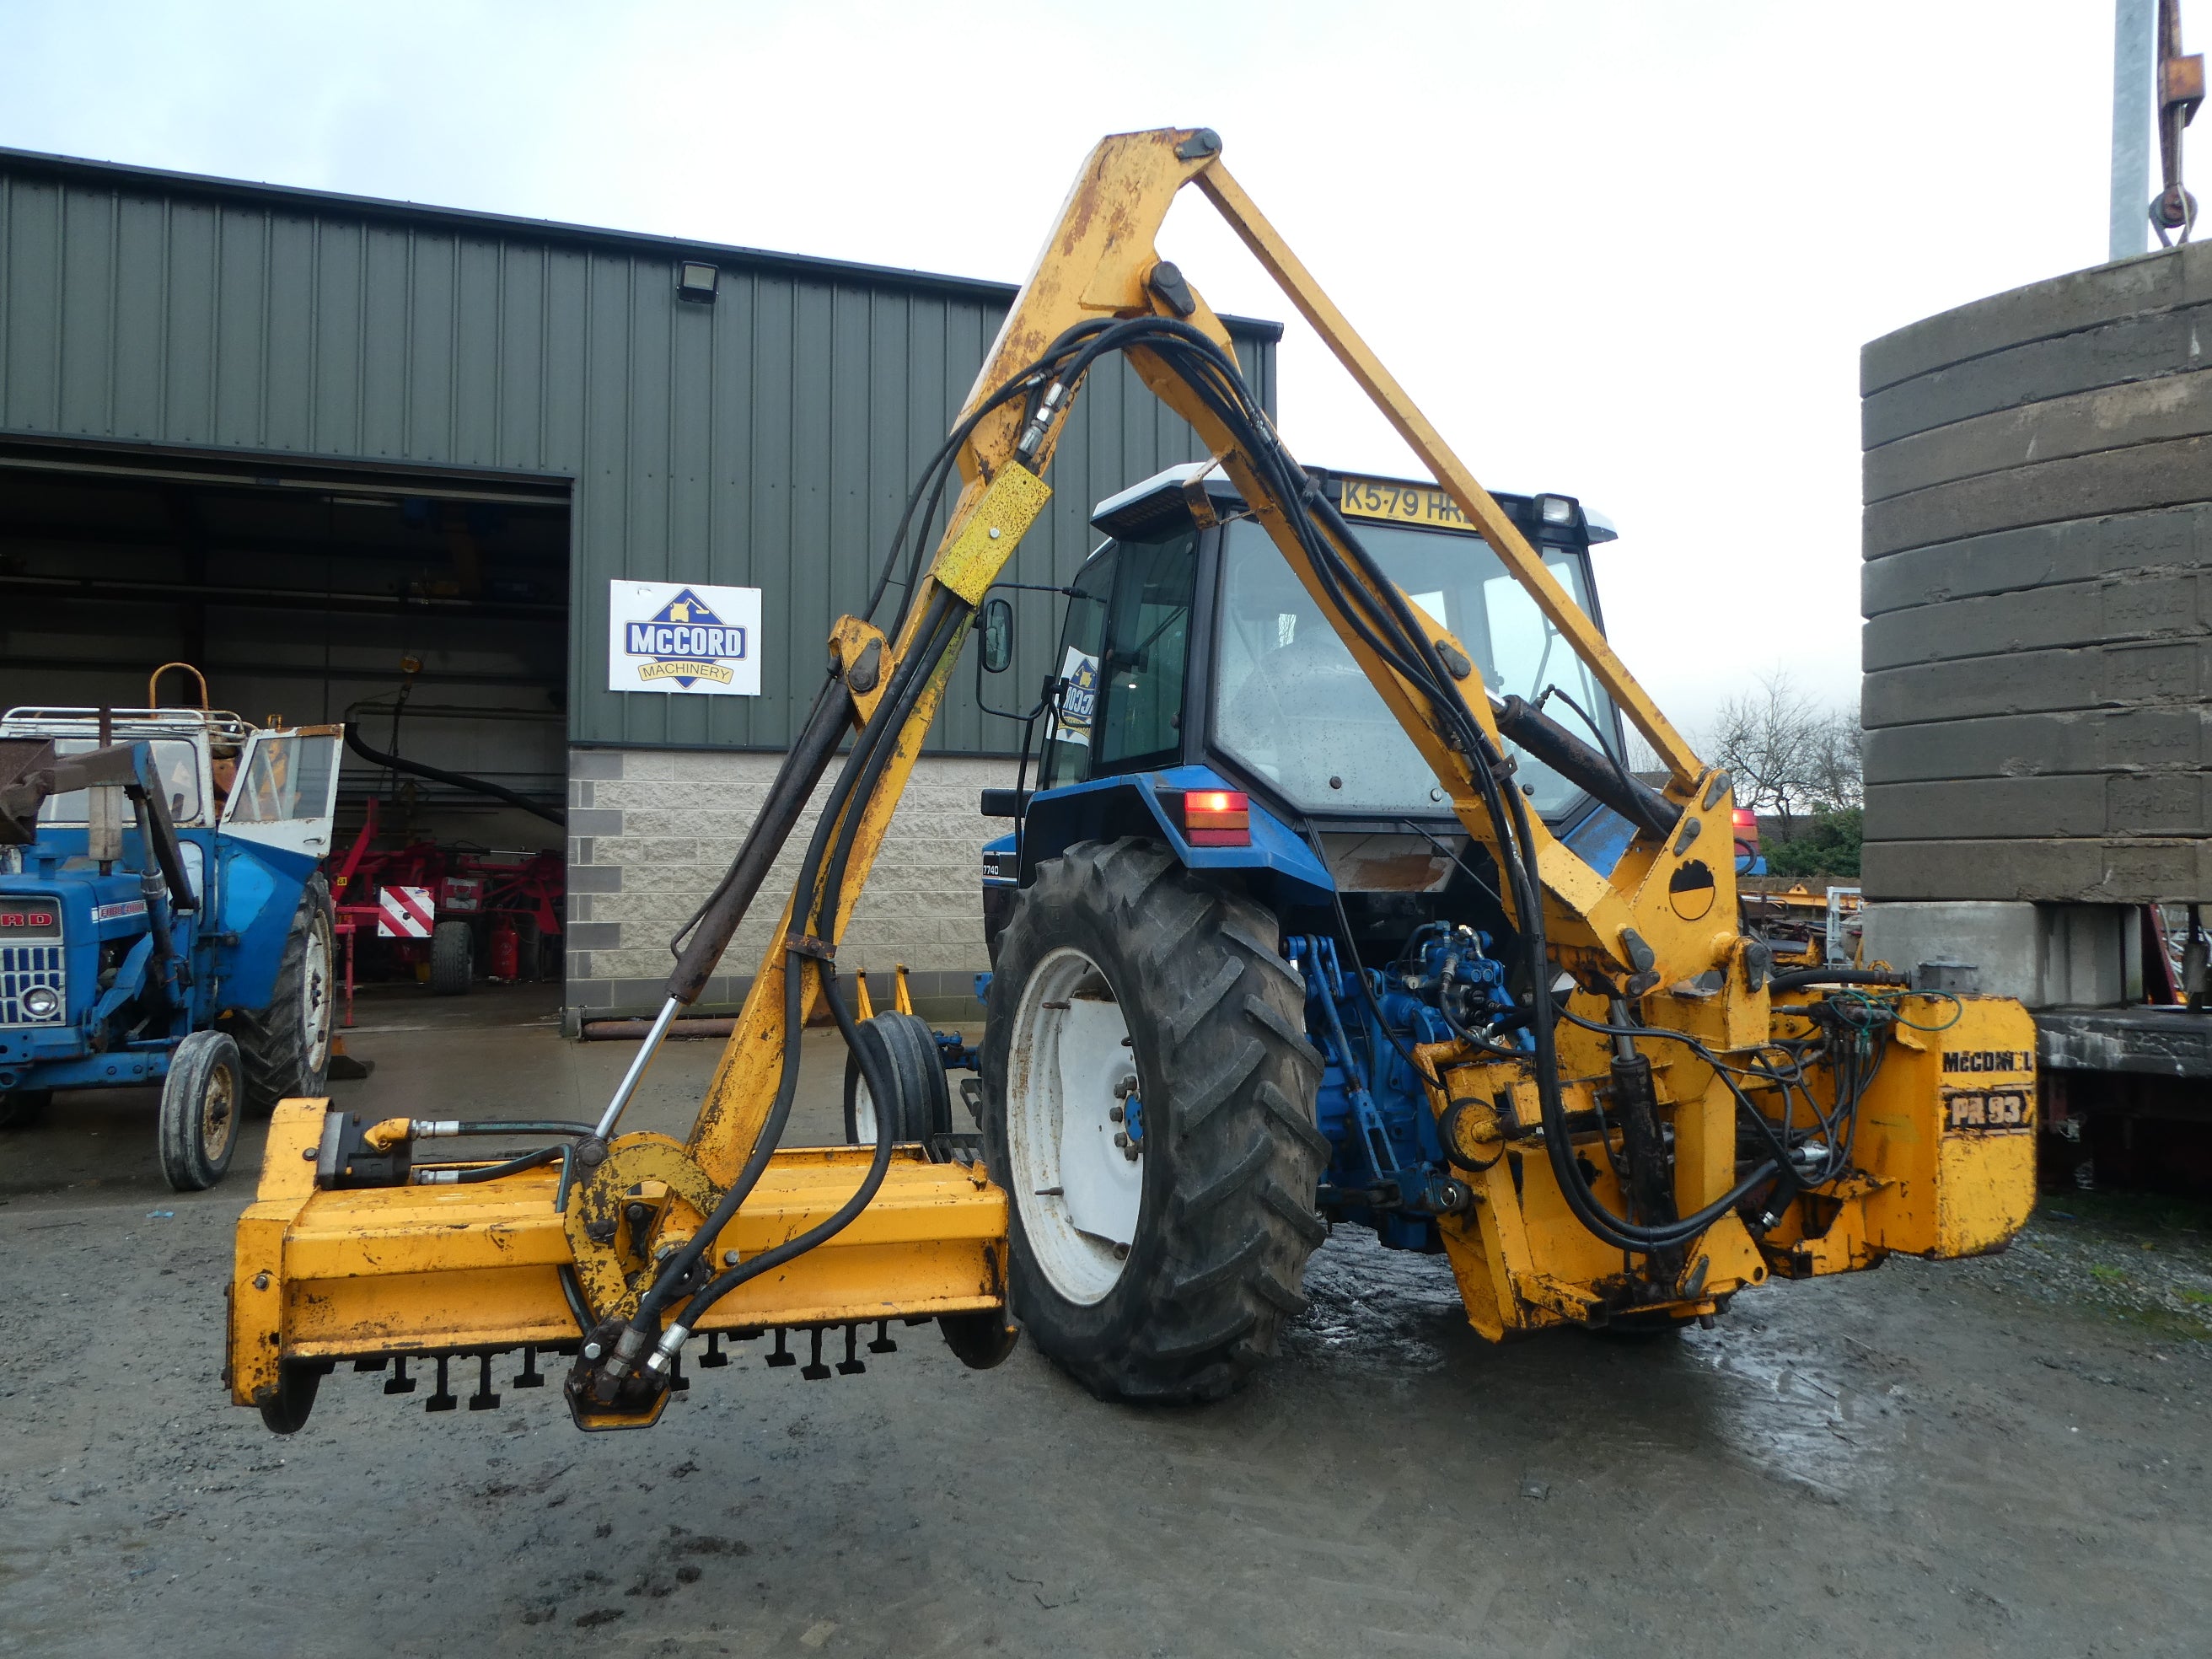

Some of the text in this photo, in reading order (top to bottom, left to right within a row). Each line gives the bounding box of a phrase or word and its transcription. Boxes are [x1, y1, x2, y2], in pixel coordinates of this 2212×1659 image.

[1345, 481, 1473, 524] K579 HR
[642, 663, 730, 680] MACHINERY
[983, 865, 999, 875] 7740
[1942, 1050, 2033, 1072] McCONNL
